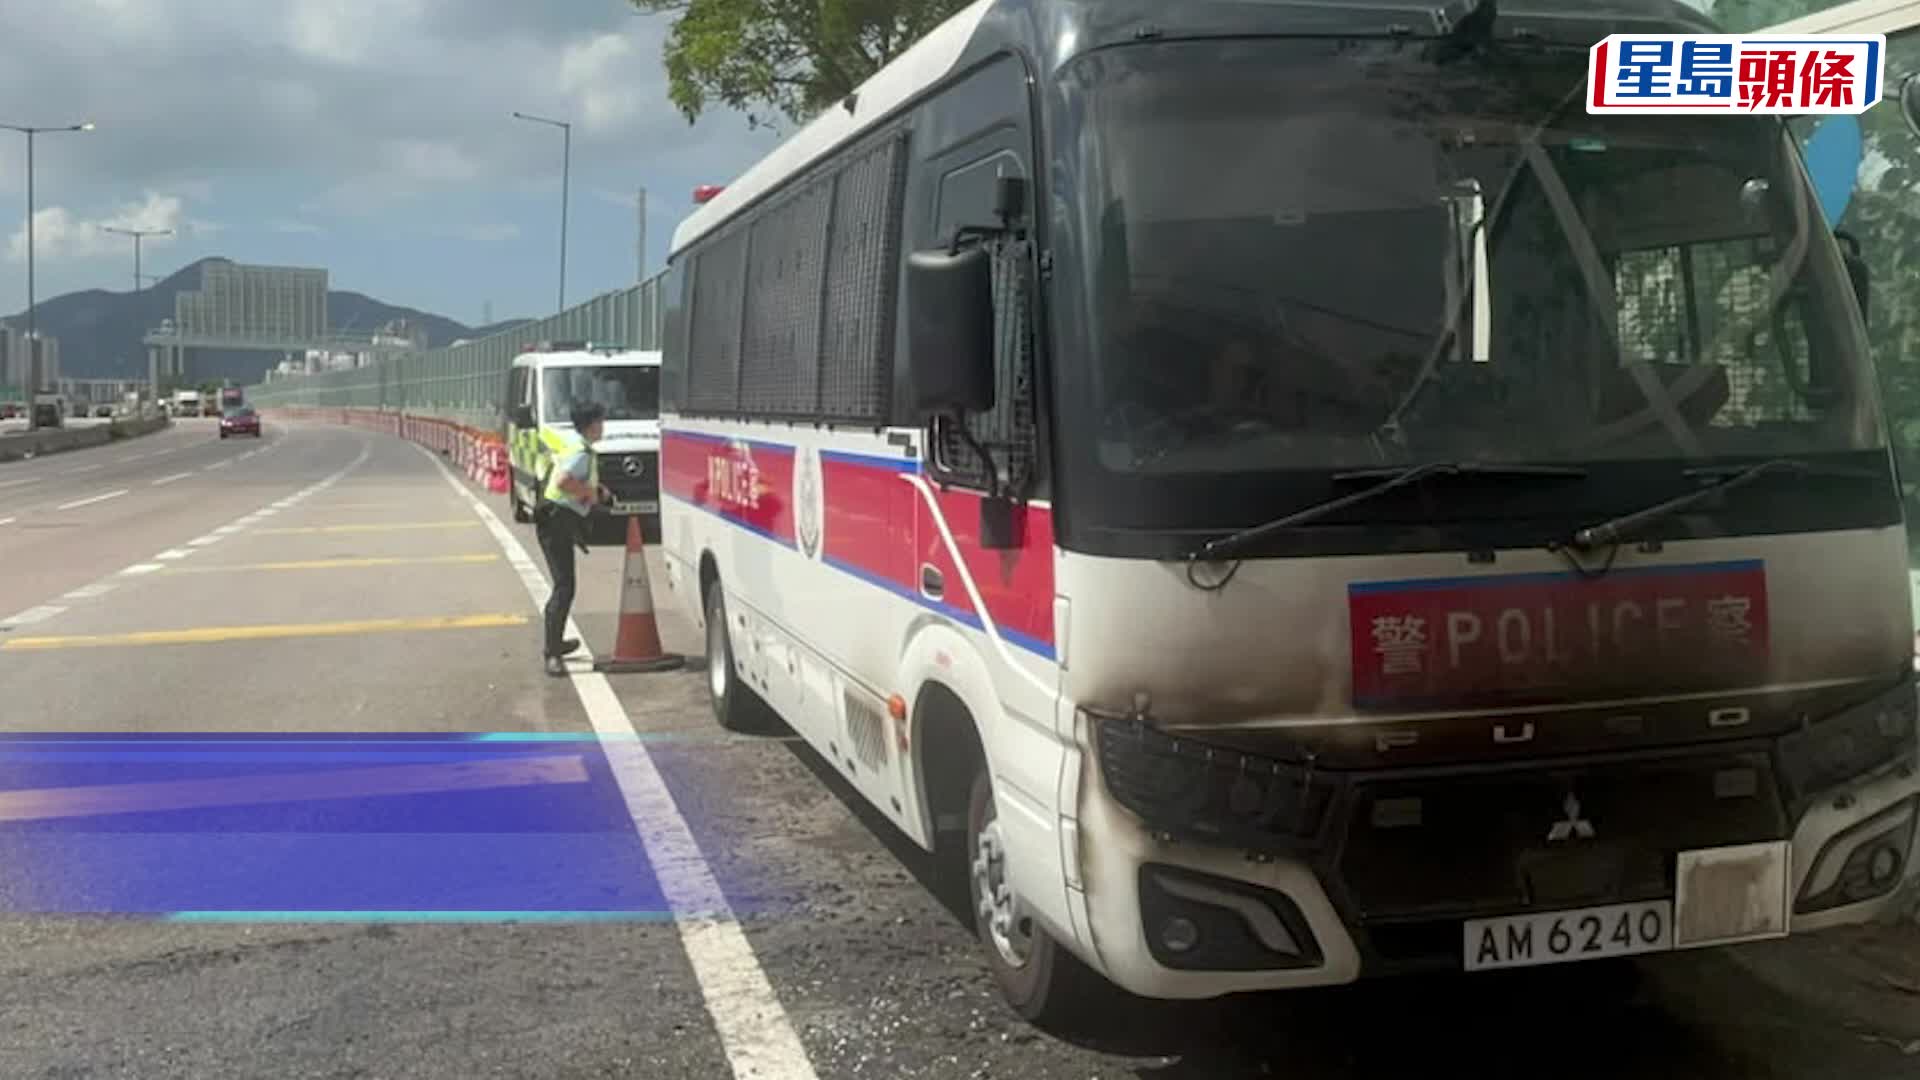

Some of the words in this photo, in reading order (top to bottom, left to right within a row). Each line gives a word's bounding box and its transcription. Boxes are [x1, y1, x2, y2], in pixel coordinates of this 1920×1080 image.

[1371, 614, 1427, 675] 警
[1447, 598, 1687, 668] POLICE
[1707, 594, 1752, 647] 察
[1477, 921, 1532, 964] AM
[1548, 909, 1661, 955] 6240
